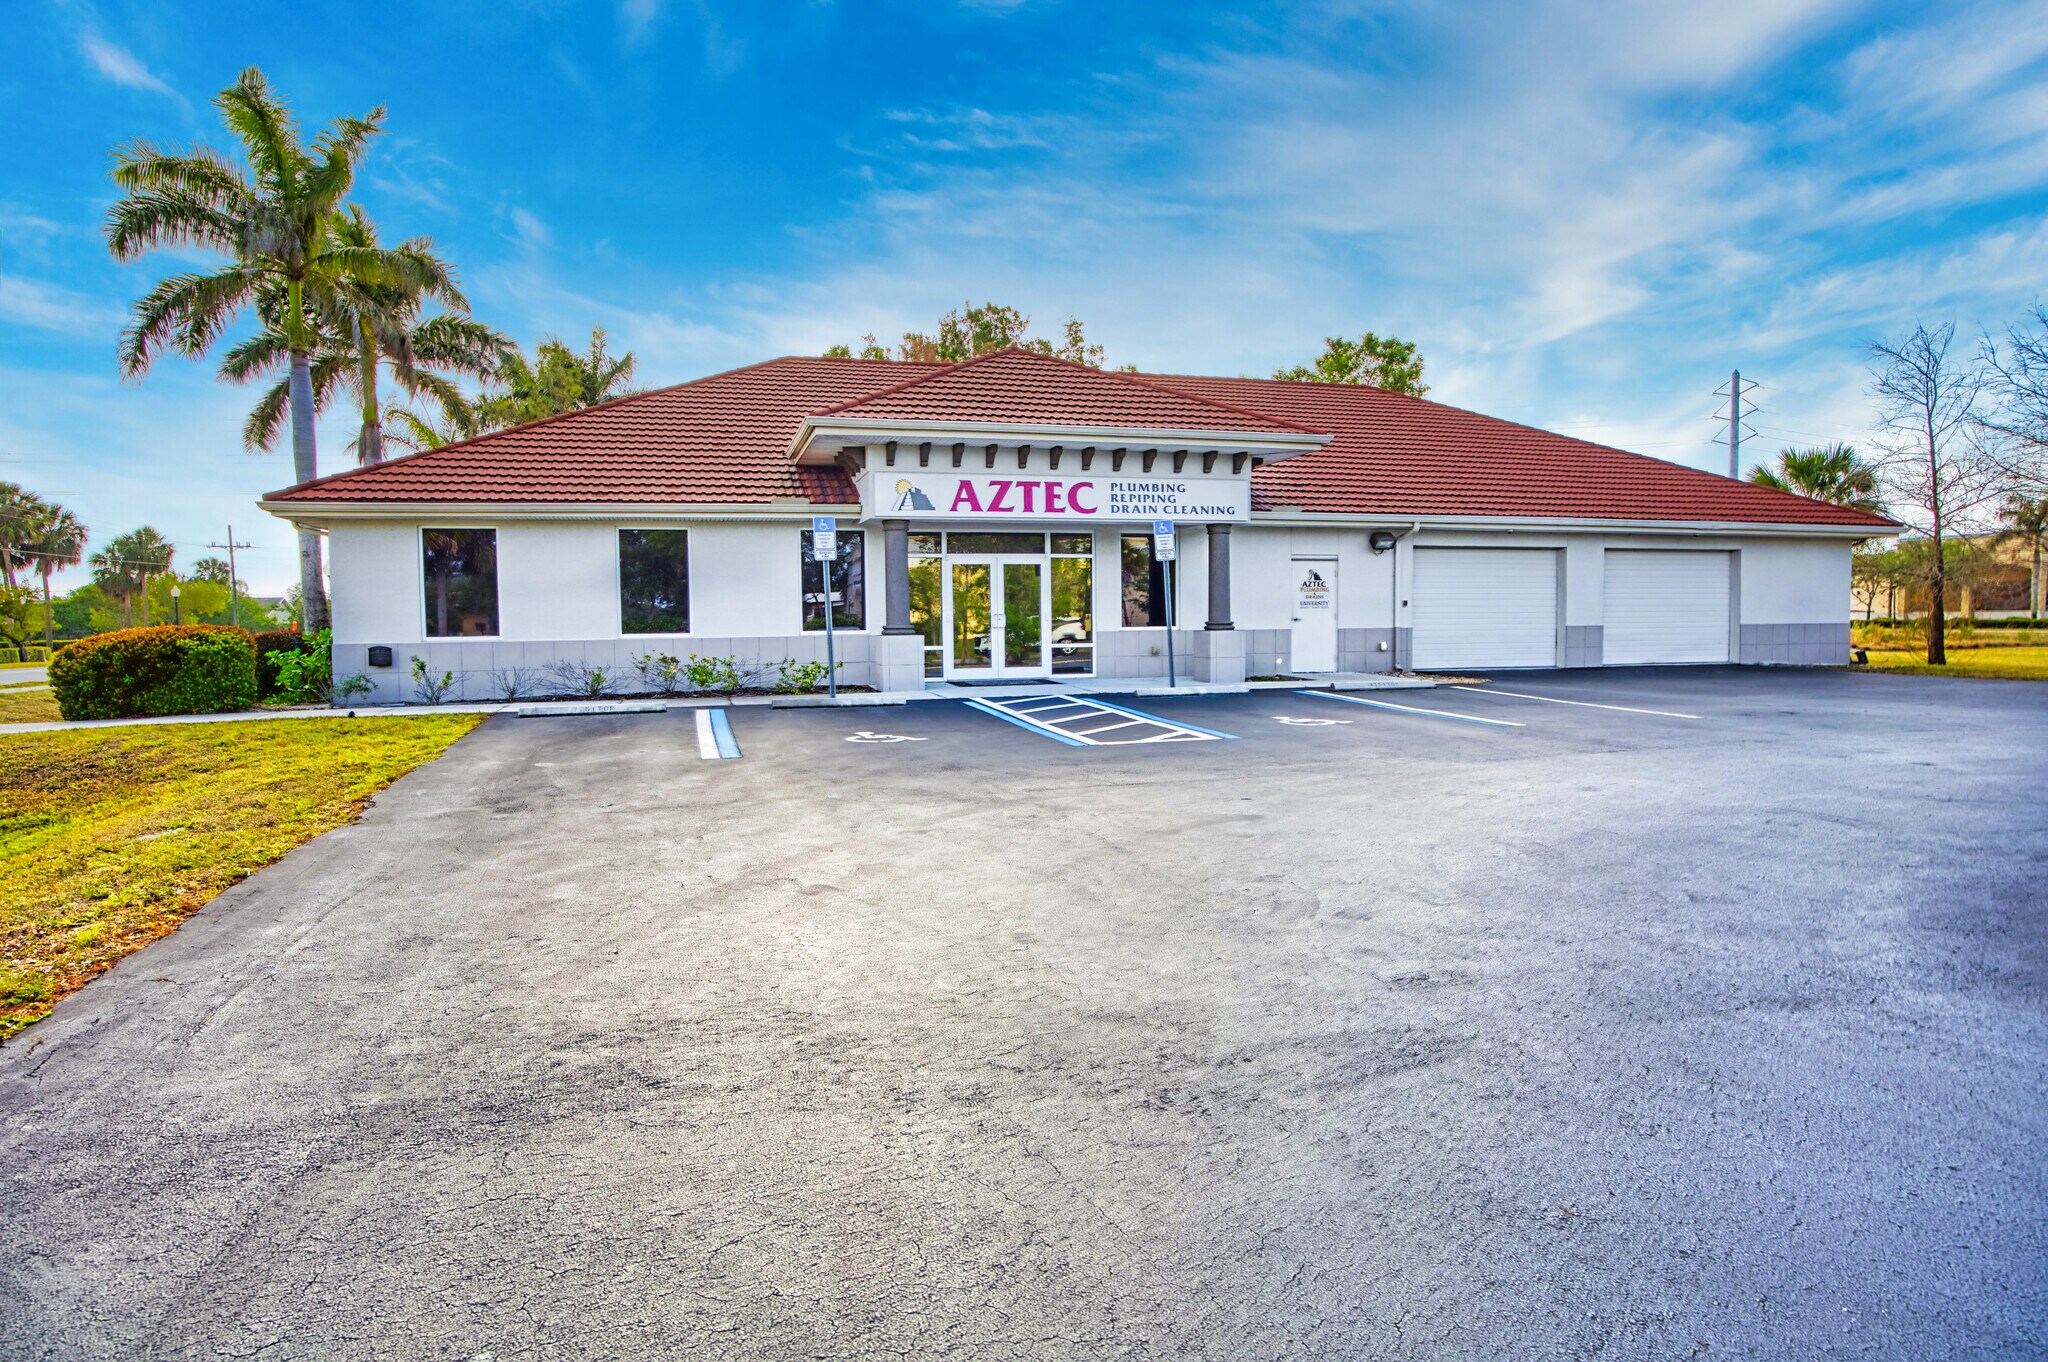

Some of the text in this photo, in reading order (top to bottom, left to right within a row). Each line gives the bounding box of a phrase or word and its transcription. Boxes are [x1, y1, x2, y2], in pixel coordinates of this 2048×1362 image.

[1110, 482, 1186, 493] PLUMBING
[949, 480, 1098, 514] AZTEC
[1110, 493, 1177, 503] REPIPING
[1111, 504, 1236, 515] DRAIN CLEANING
